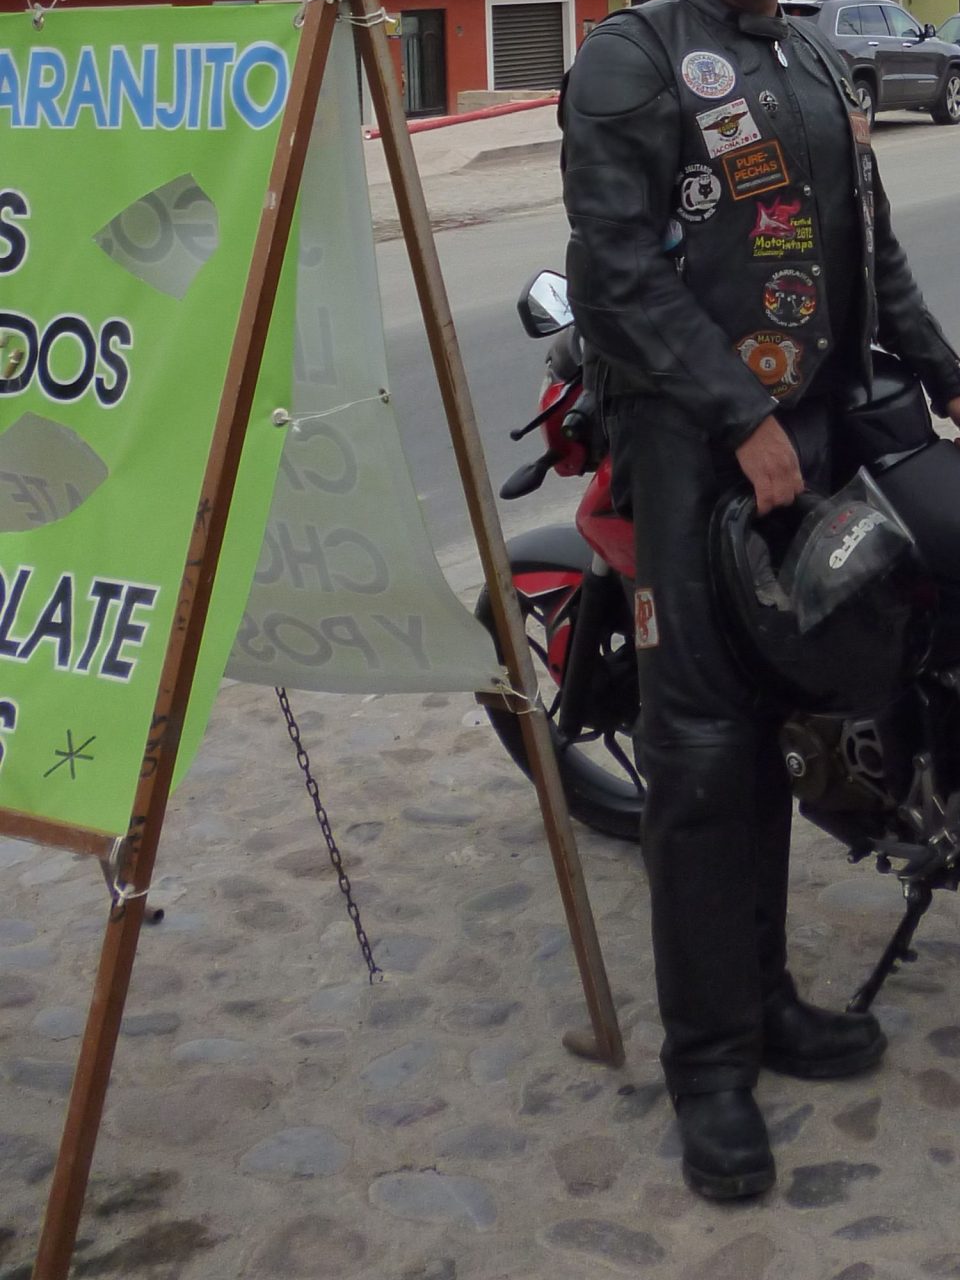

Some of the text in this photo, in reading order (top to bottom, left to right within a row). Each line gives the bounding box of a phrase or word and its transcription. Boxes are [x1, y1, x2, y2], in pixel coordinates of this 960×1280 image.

[734, 160, 778, 181] PECHAS
[757, 335, 782, 345] MAYO
[0, 564, 160, 684] LATE
